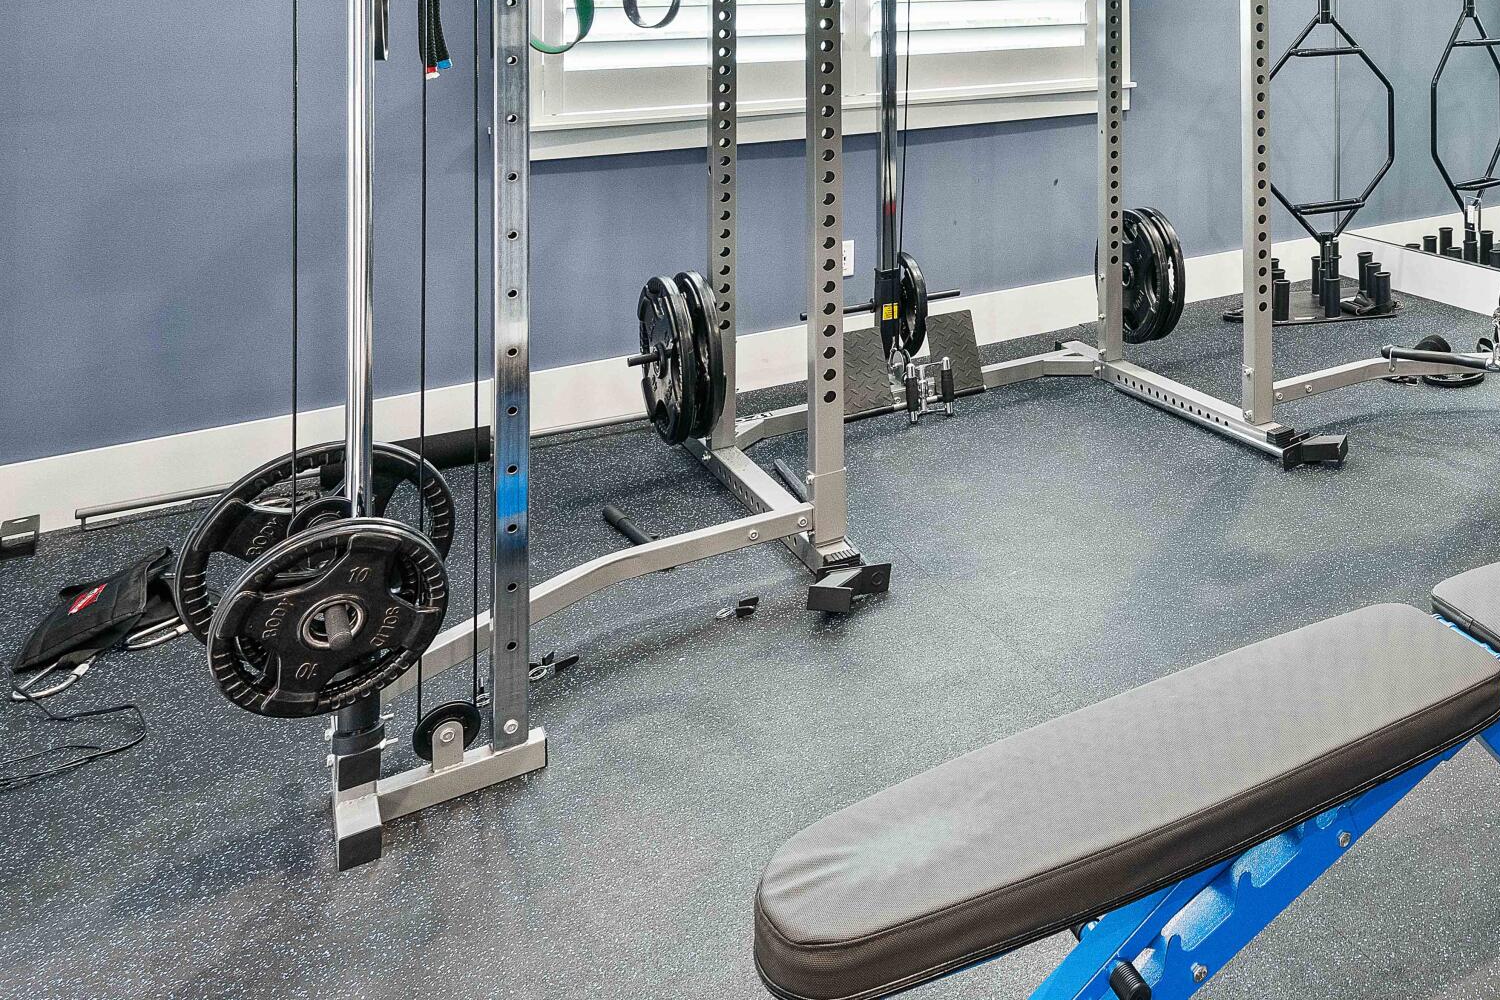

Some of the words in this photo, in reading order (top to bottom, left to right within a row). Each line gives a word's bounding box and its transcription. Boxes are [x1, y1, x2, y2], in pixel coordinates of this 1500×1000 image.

[246, 517, 283, 556] BODY
[348, 567, 370, 583] 10
[262, 597, 294, 640] BODY
[369, 606, 400, 648] SOLID
[295, 662, 318, 681] 10
